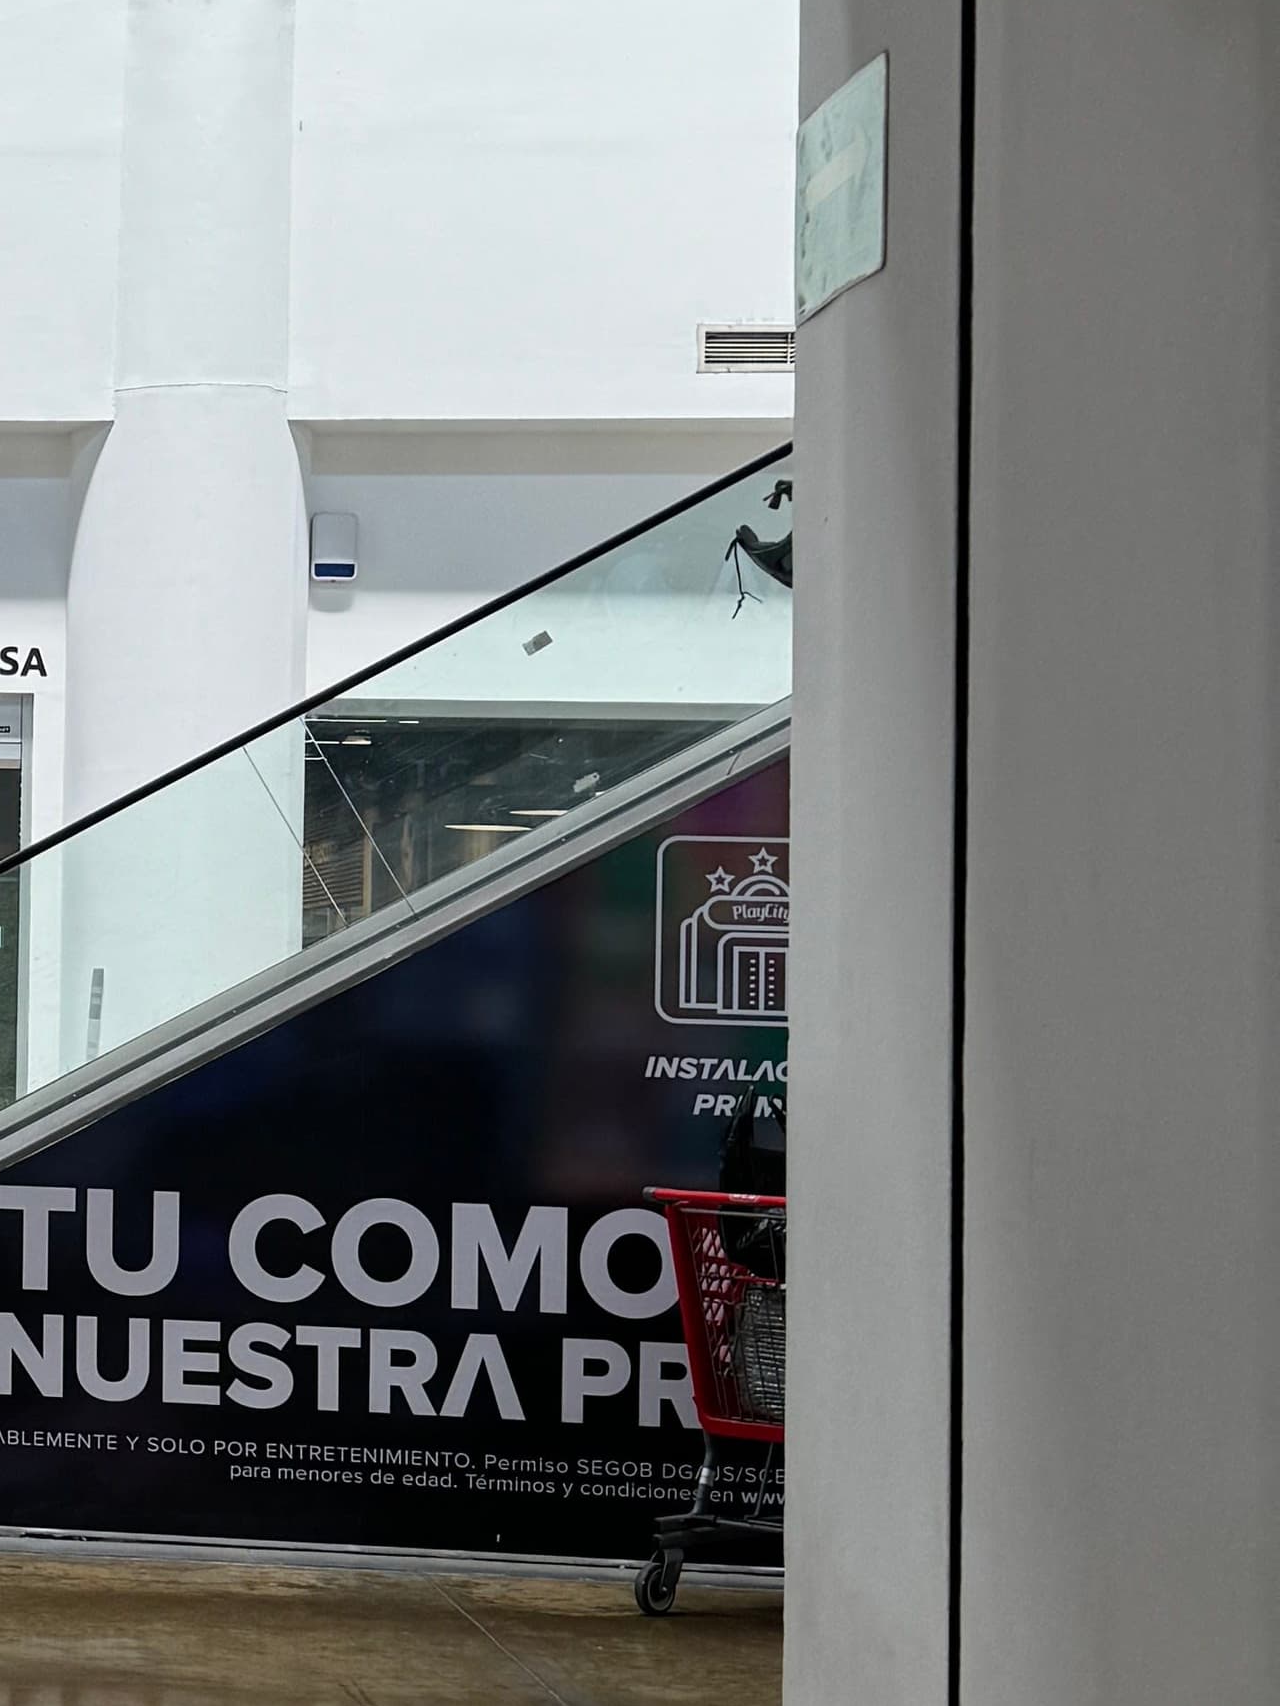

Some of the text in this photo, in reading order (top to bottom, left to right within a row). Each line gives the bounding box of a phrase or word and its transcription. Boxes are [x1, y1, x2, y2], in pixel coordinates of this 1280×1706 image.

[227, 1193, 680, 1320] COMO
[560, 1336, 705, 1430] PR
[125, 1435, 140, 1451] Y
[147, 1436, 206, 1455] SOLO
[214, 1440, 258, 1458] POR
[266, 1443, 476, 1470] ENTRETENIMIENTO.
[485, 1454, 569, 1474] Permiso
[576, 1458, 653, 1478] SEGOB
[230, 1464, 272, 1481] para
[278, 1467, 364, 1485] menores
[370, 1469, 395, 1486] de
[402, 1471, 459, 1489] edad.
[465, 1473, 556, 1494] Términos
[562, 1481, 574, 1499] y
[580, 1480, 700, 1501] condiciones
[709, 1489, 735, 1503] en
